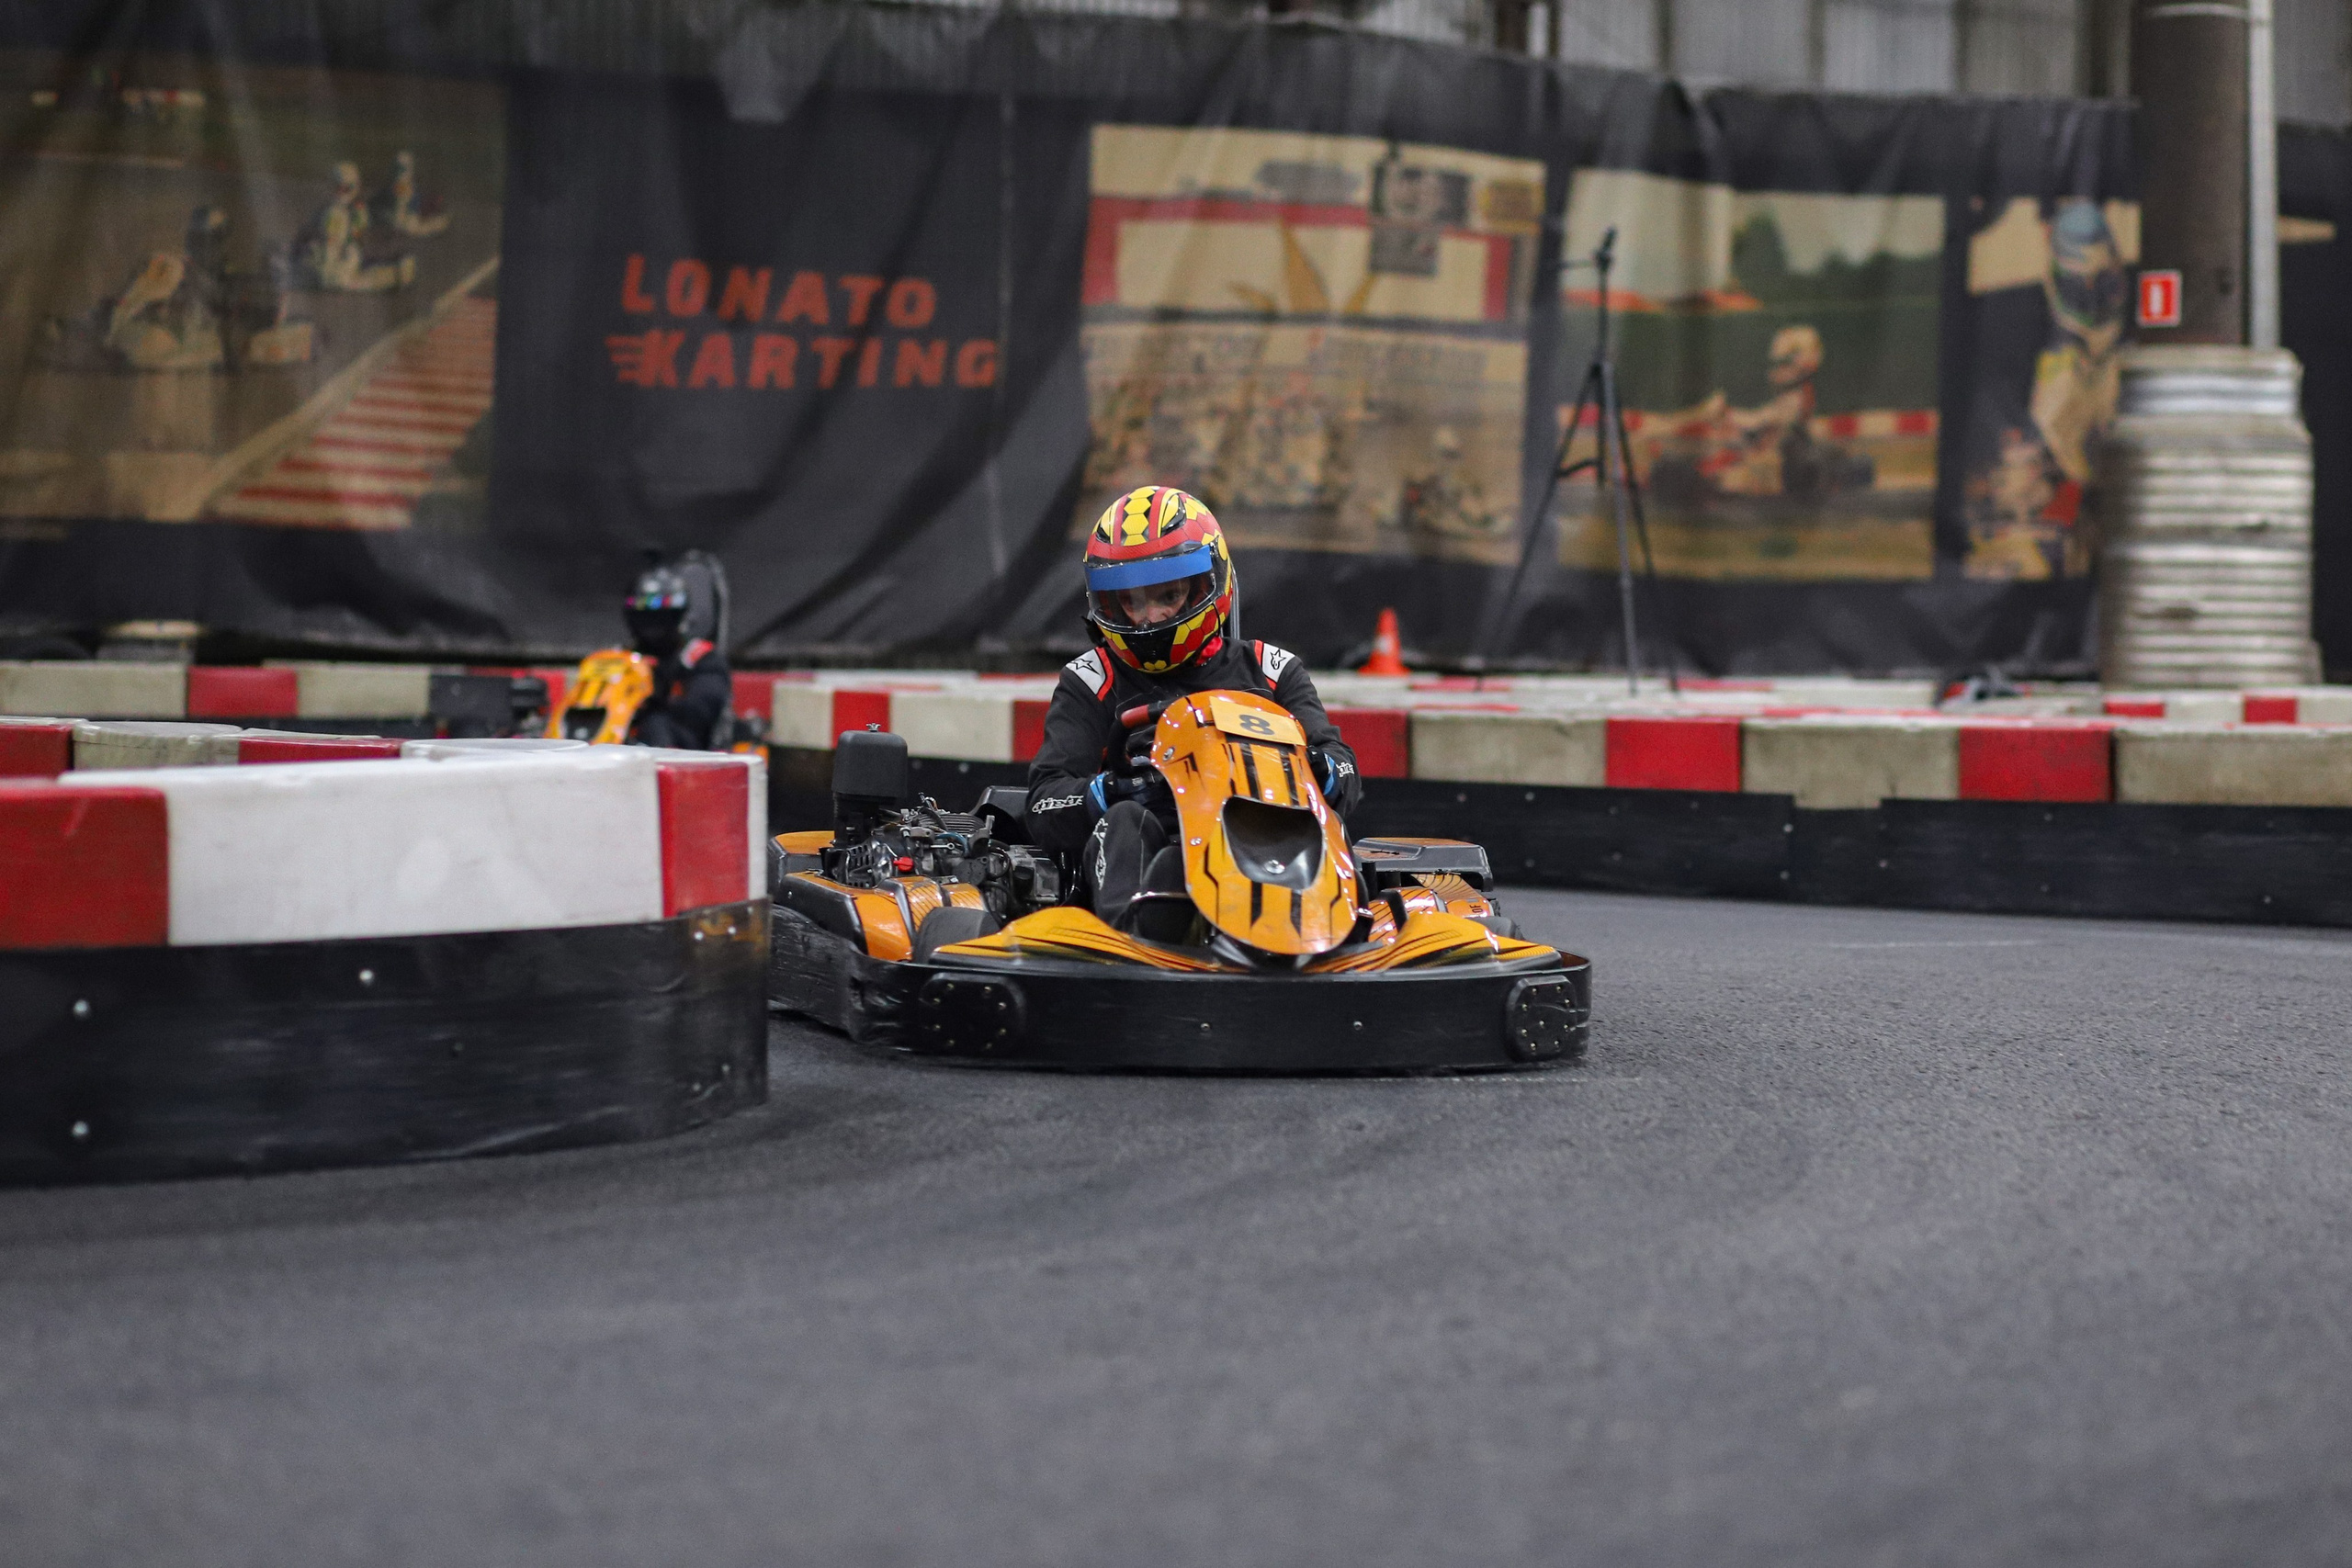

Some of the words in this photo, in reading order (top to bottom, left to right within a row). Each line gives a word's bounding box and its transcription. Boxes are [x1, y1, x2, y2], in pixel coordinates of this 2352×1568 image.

[620, 254, 936, 329] LONATO
[636, 328, 1000, 389] KARTING
[1238, 714, 1275, 736] 8
